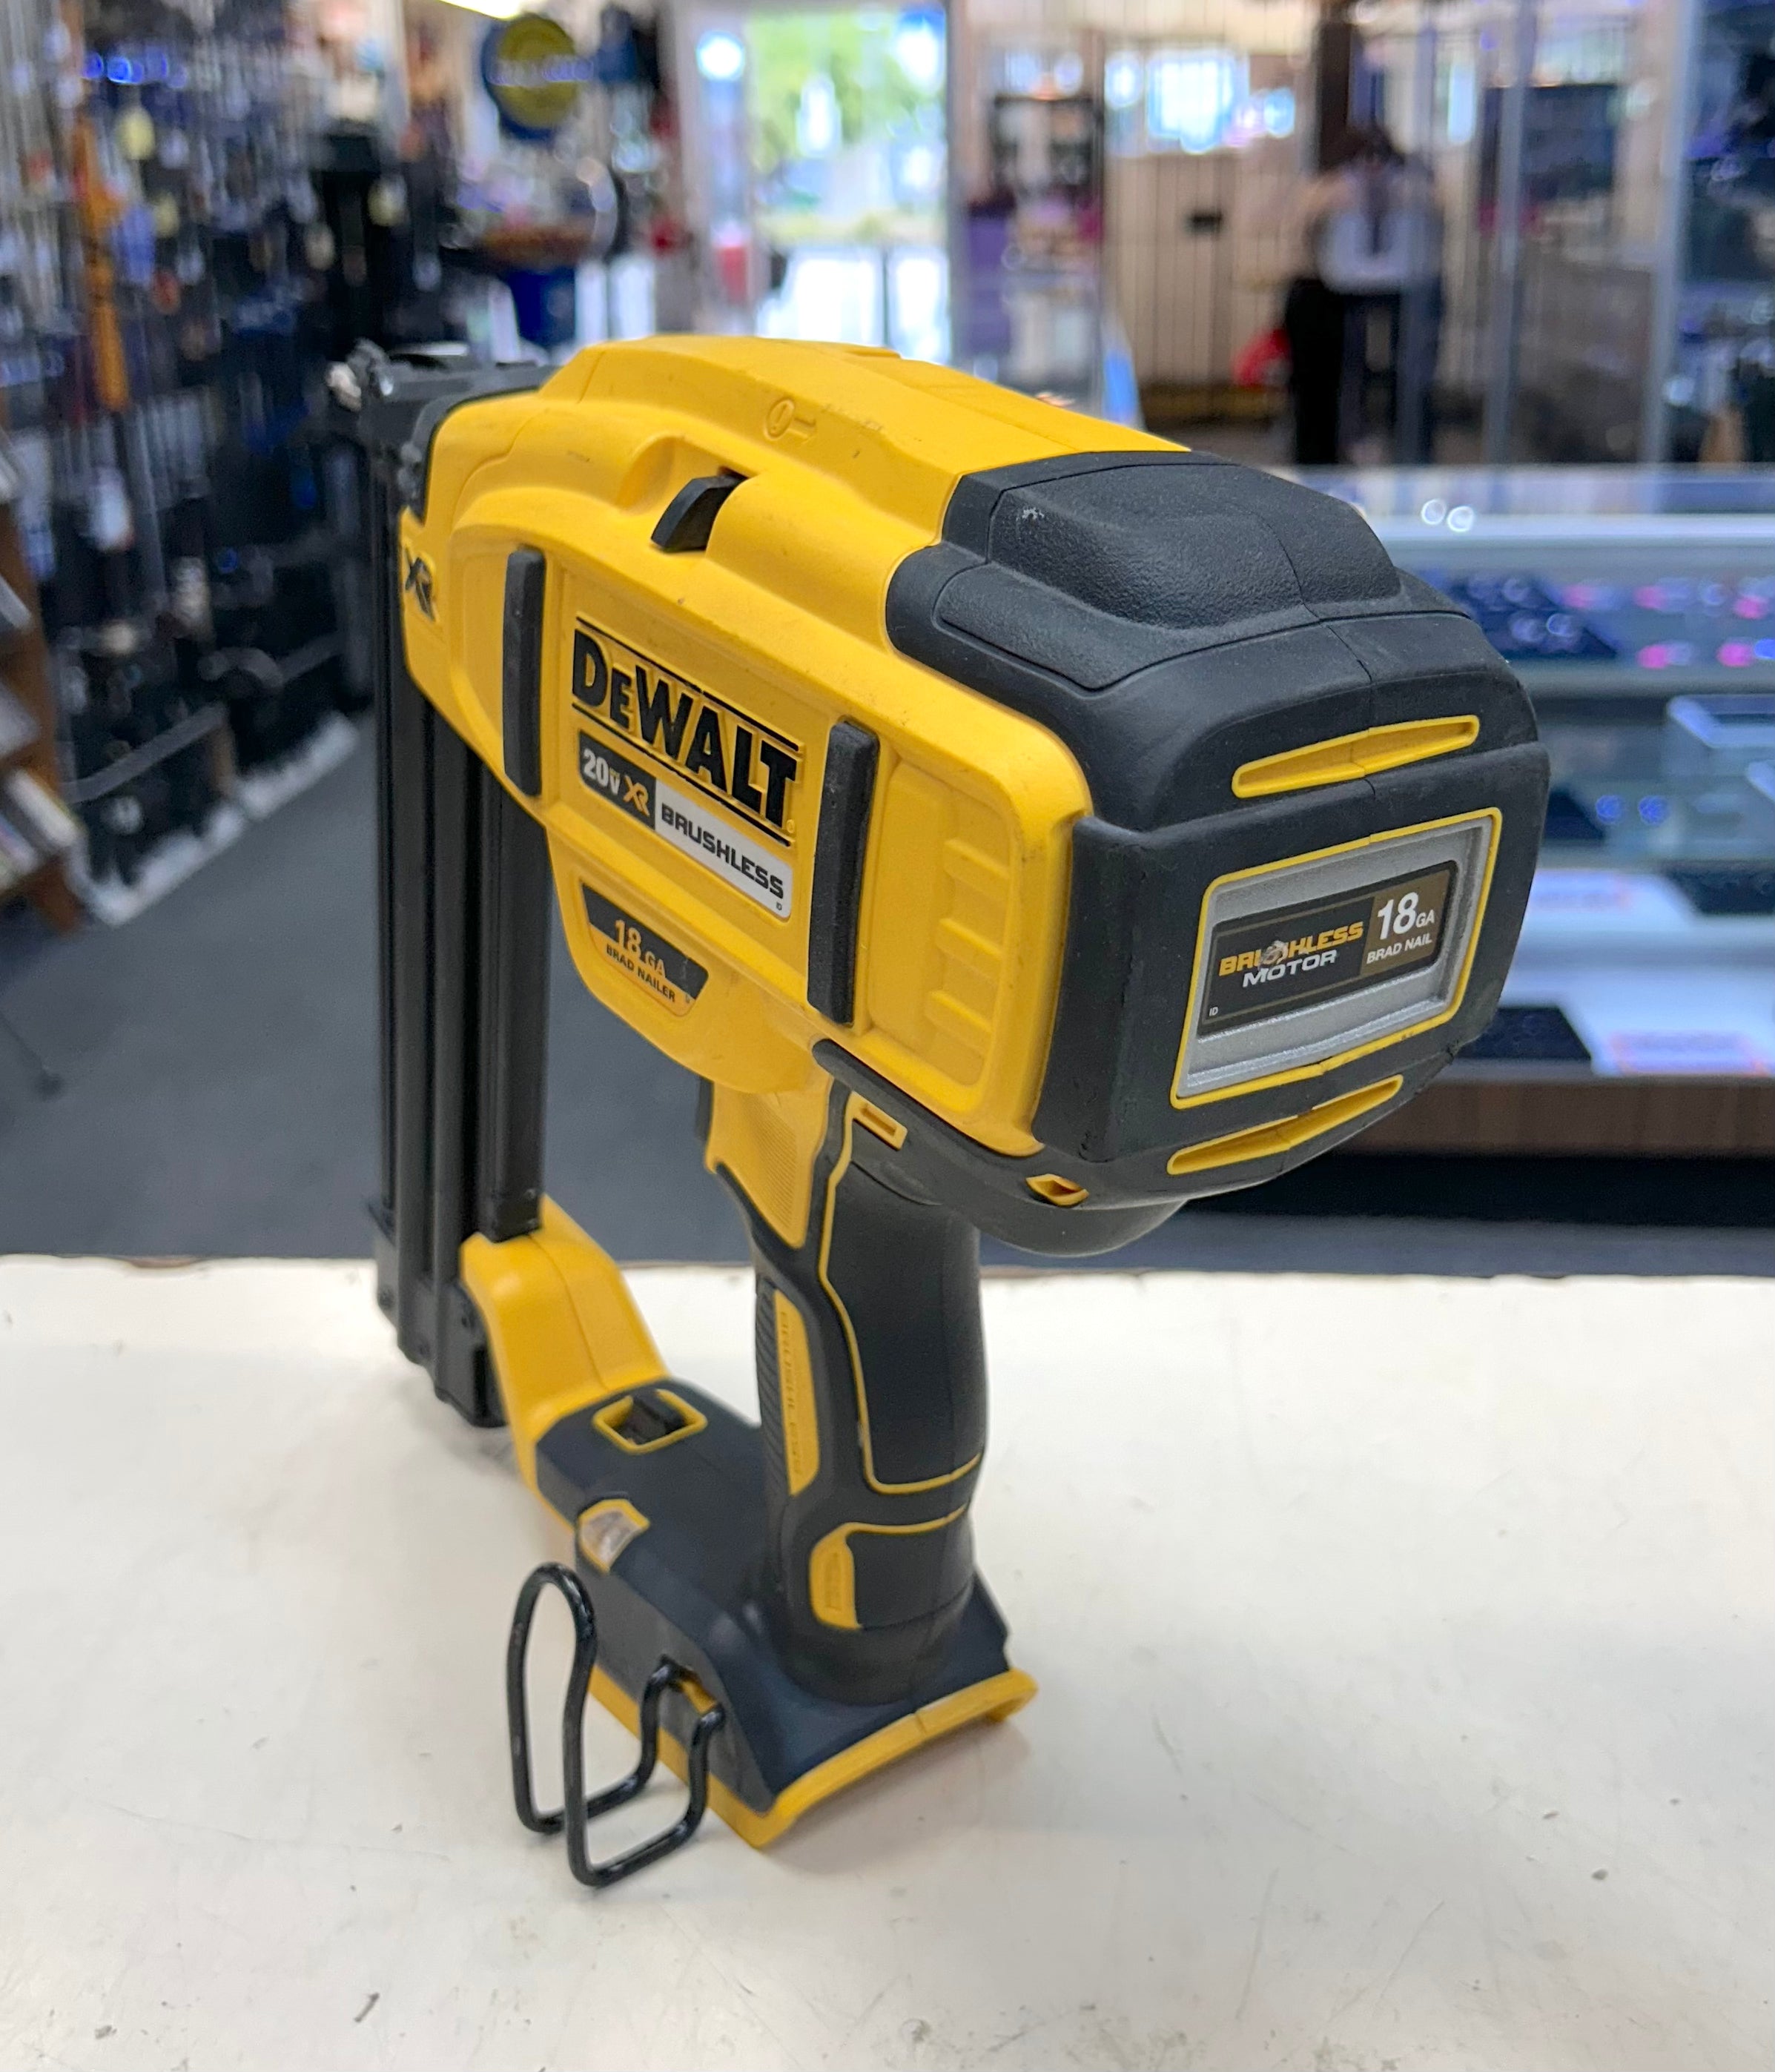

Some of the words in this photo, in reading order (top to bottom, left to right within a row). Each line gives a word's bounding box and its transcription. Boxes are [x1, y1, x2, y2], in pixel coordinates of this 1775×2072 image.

[623, 775, 651, 818] XR
[661, 802, 784, 899] BRUSHLESS
[1218, 921, 1364, 977] BRHLESS
[1242, 949, 1338, 988] MOTOR
[1366, 942, 1403, 964] BRAD
[1404, 932, 1433, 952] NAIL
[606, 943, 635, 973] BRAD
[637, 966, 676, 1003] NAILER
[1209, 1005, 1220, 1016] ID
